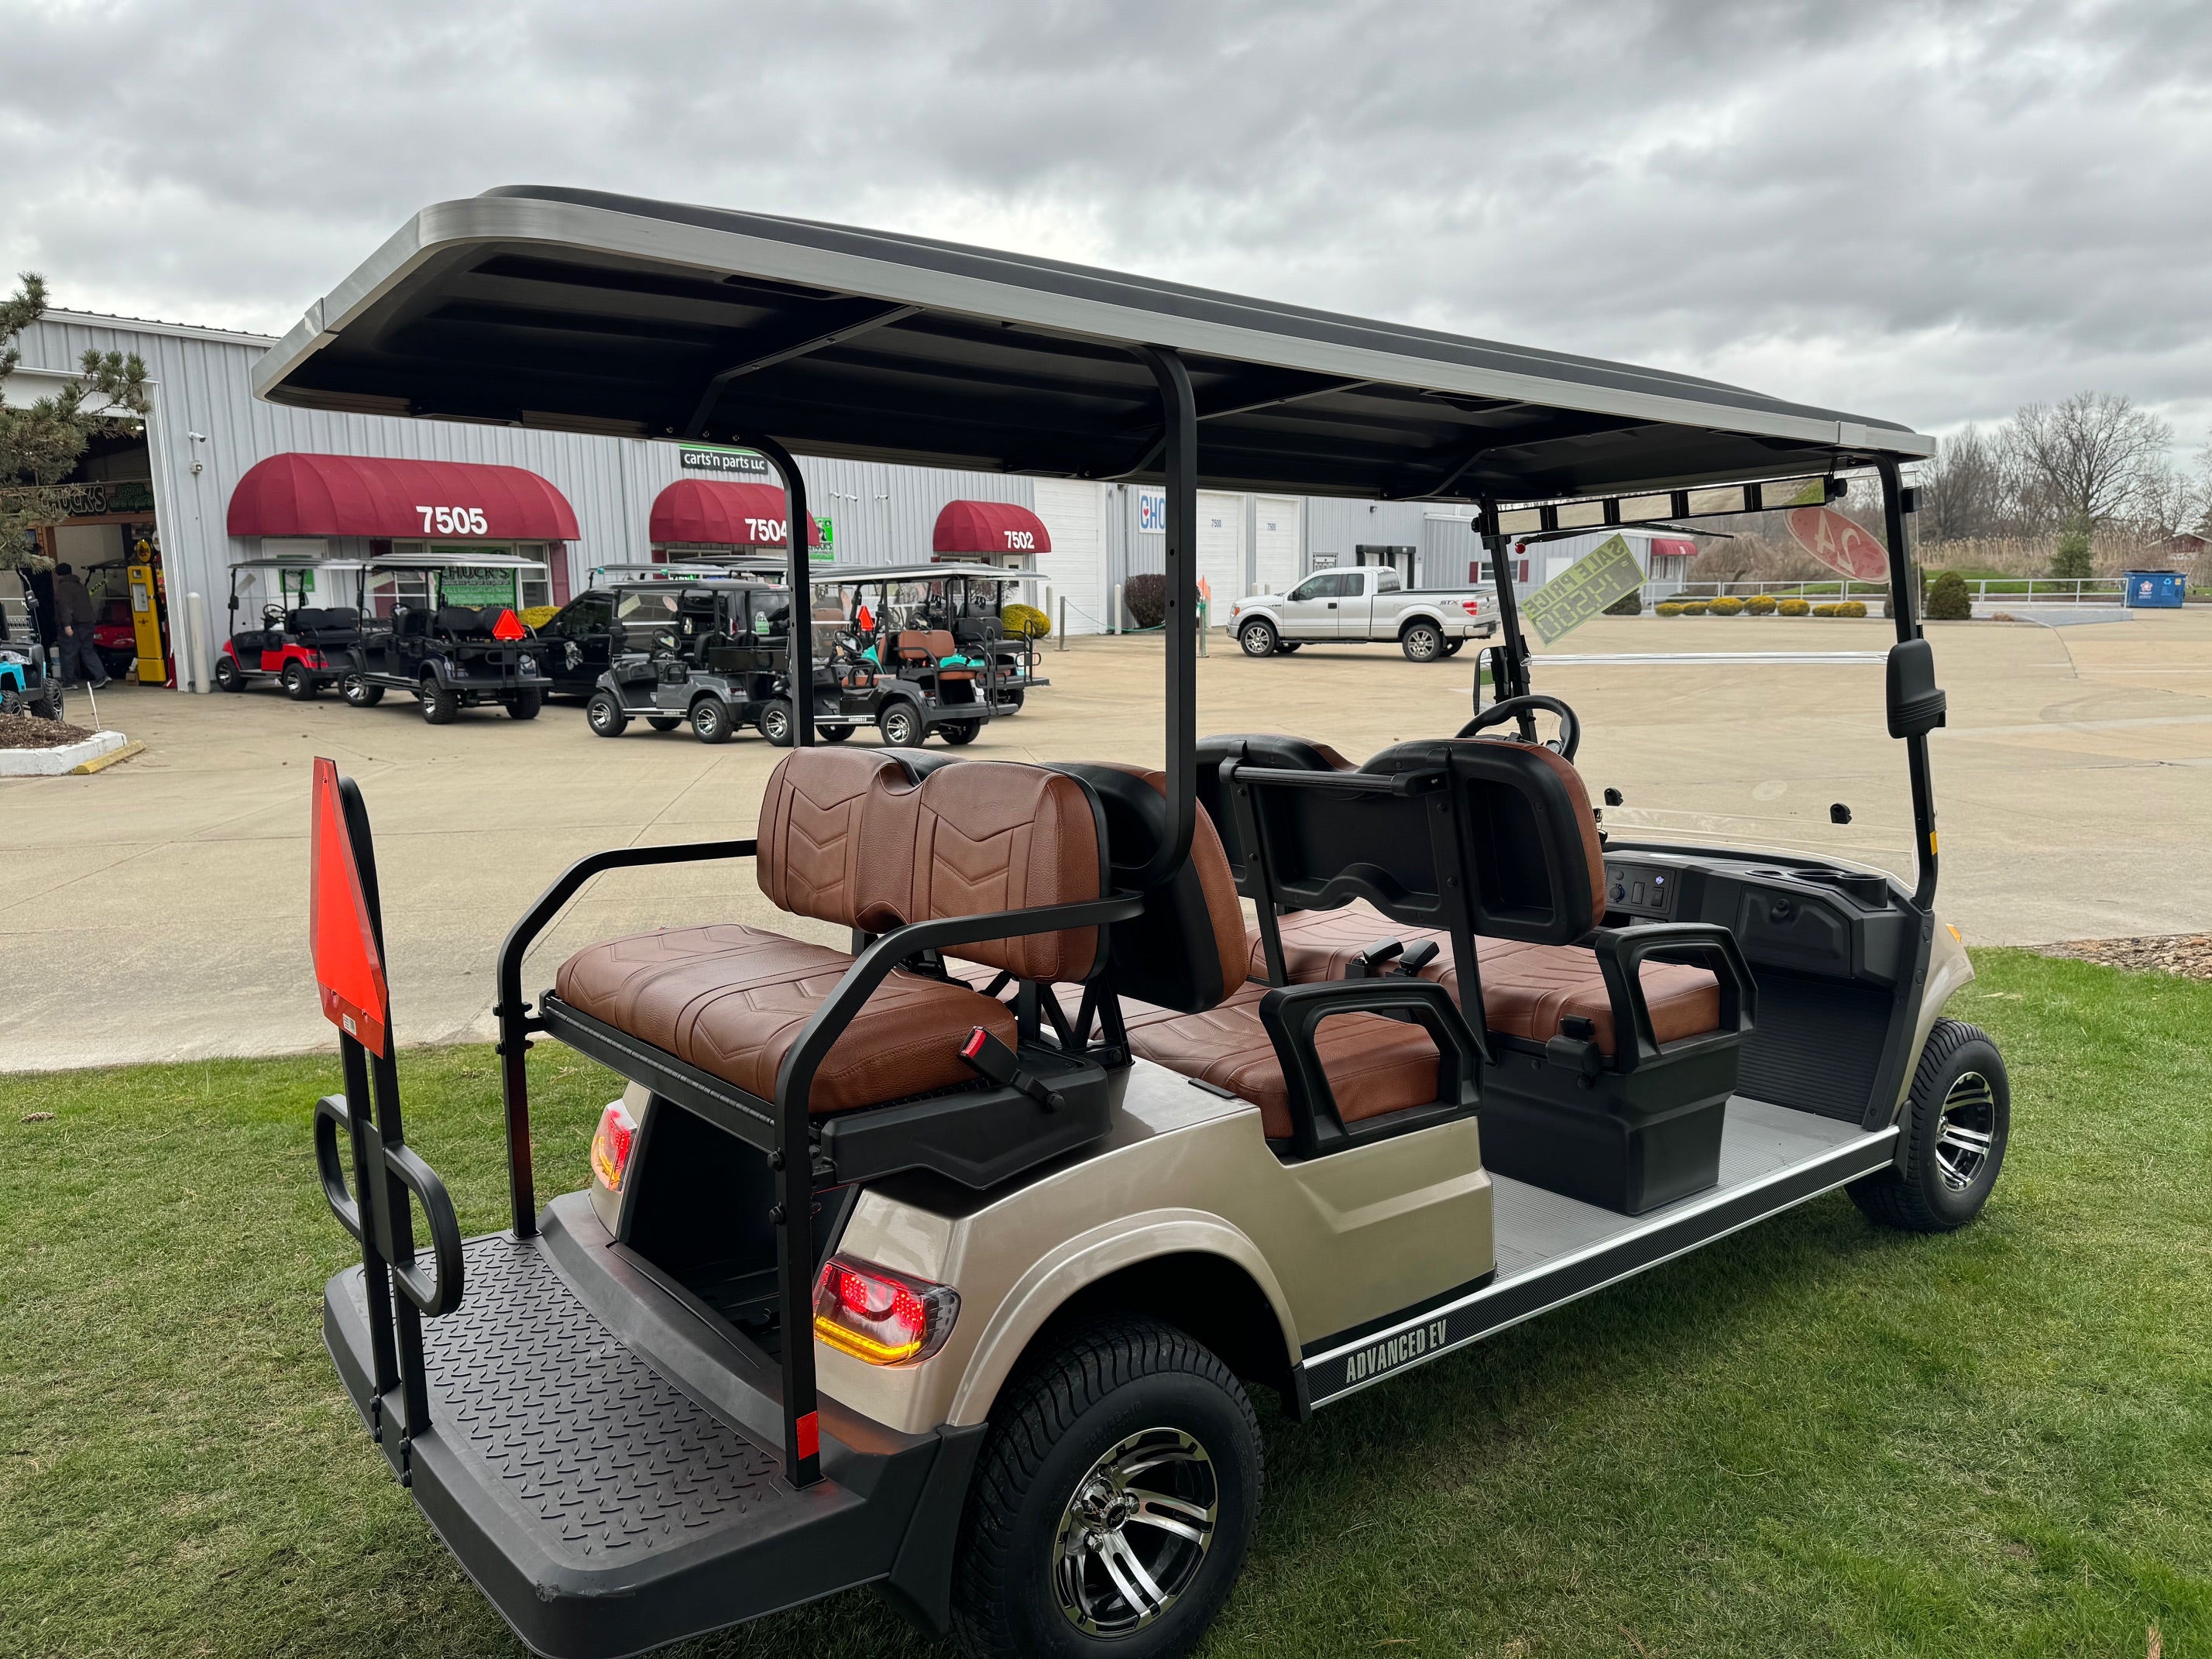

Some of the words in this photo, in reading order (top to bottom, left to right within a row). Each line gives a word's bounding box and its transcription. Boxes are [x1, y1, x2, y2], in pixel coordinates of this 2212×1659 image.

[684, 452, 720, 466] carts'n
[723, 455, 749, 469] parts
[750, 459, 765, 470] LLC
[415, 505, 488, 535] 7505
[1211, 518, 1222, 528] 7500
[1266, 523, 1276, 531] 7500
[1004, 531, 1036, 549] 7502
[90, 579, 106, 593] SOLD
[1346, 1328, 1425, 1383] ADVANCED
[1429, 1319, 1447, 1349] EV
